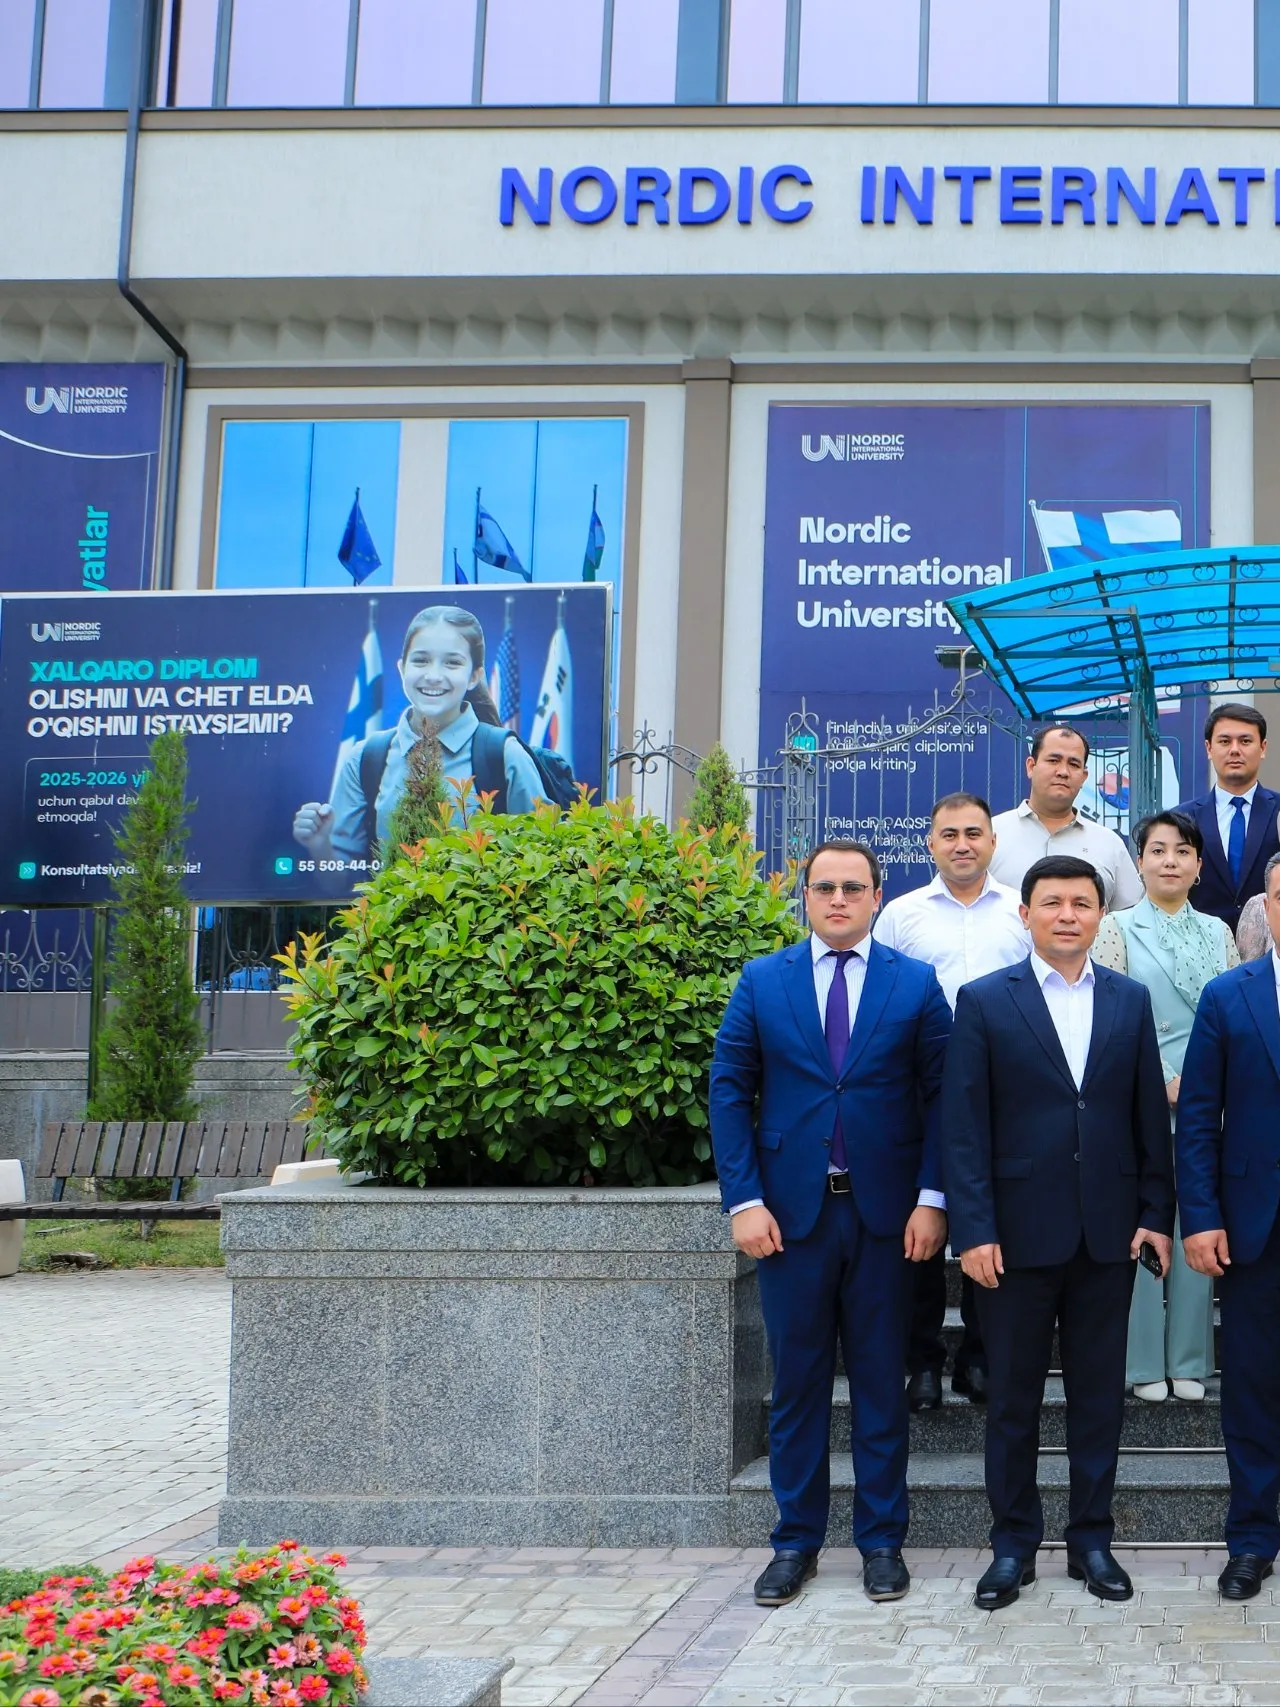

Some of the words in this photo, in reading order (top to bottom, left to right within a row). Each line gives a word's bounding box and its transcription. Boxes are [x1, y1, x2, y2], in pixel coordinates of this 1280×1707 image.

[500, 165, 813, 226] NORDIC
[75, 387, 128, 398] NORDIC
[74, 406, 128, 414] UNIVERSITY
[851, 434, 905, 446] NORDIC
[851, 453, 905, 461] UNIVERSITY
[799, 515, 912, 544] Nordic
[798, 556, 1012, 586] International
[64, 622, 102, 631] NORDIC
[30, 659, 155, 683] XALQARO
[160, 657, 258, 681] DIPLOM
[29, 688, 128, 710] OLISHNI
[134, 687, 170, 708] VA
[175, 685, 245, 707] CHET
[249, 684, 314, 706] ELDA
[28, 715, 138, 738] O'QISHNI
[144, 712, 294, 736] ISTAYSIZMI?
[914, 739, 974, 755] diplomni
[40, 771, 127, 787] 2025-2026
[38, 795, 76, 807] uchun
[80, 794, 114, 808] qabul
[37, 811, 97, 825] etmoqda!
[298, 860, 316, 872] 55
